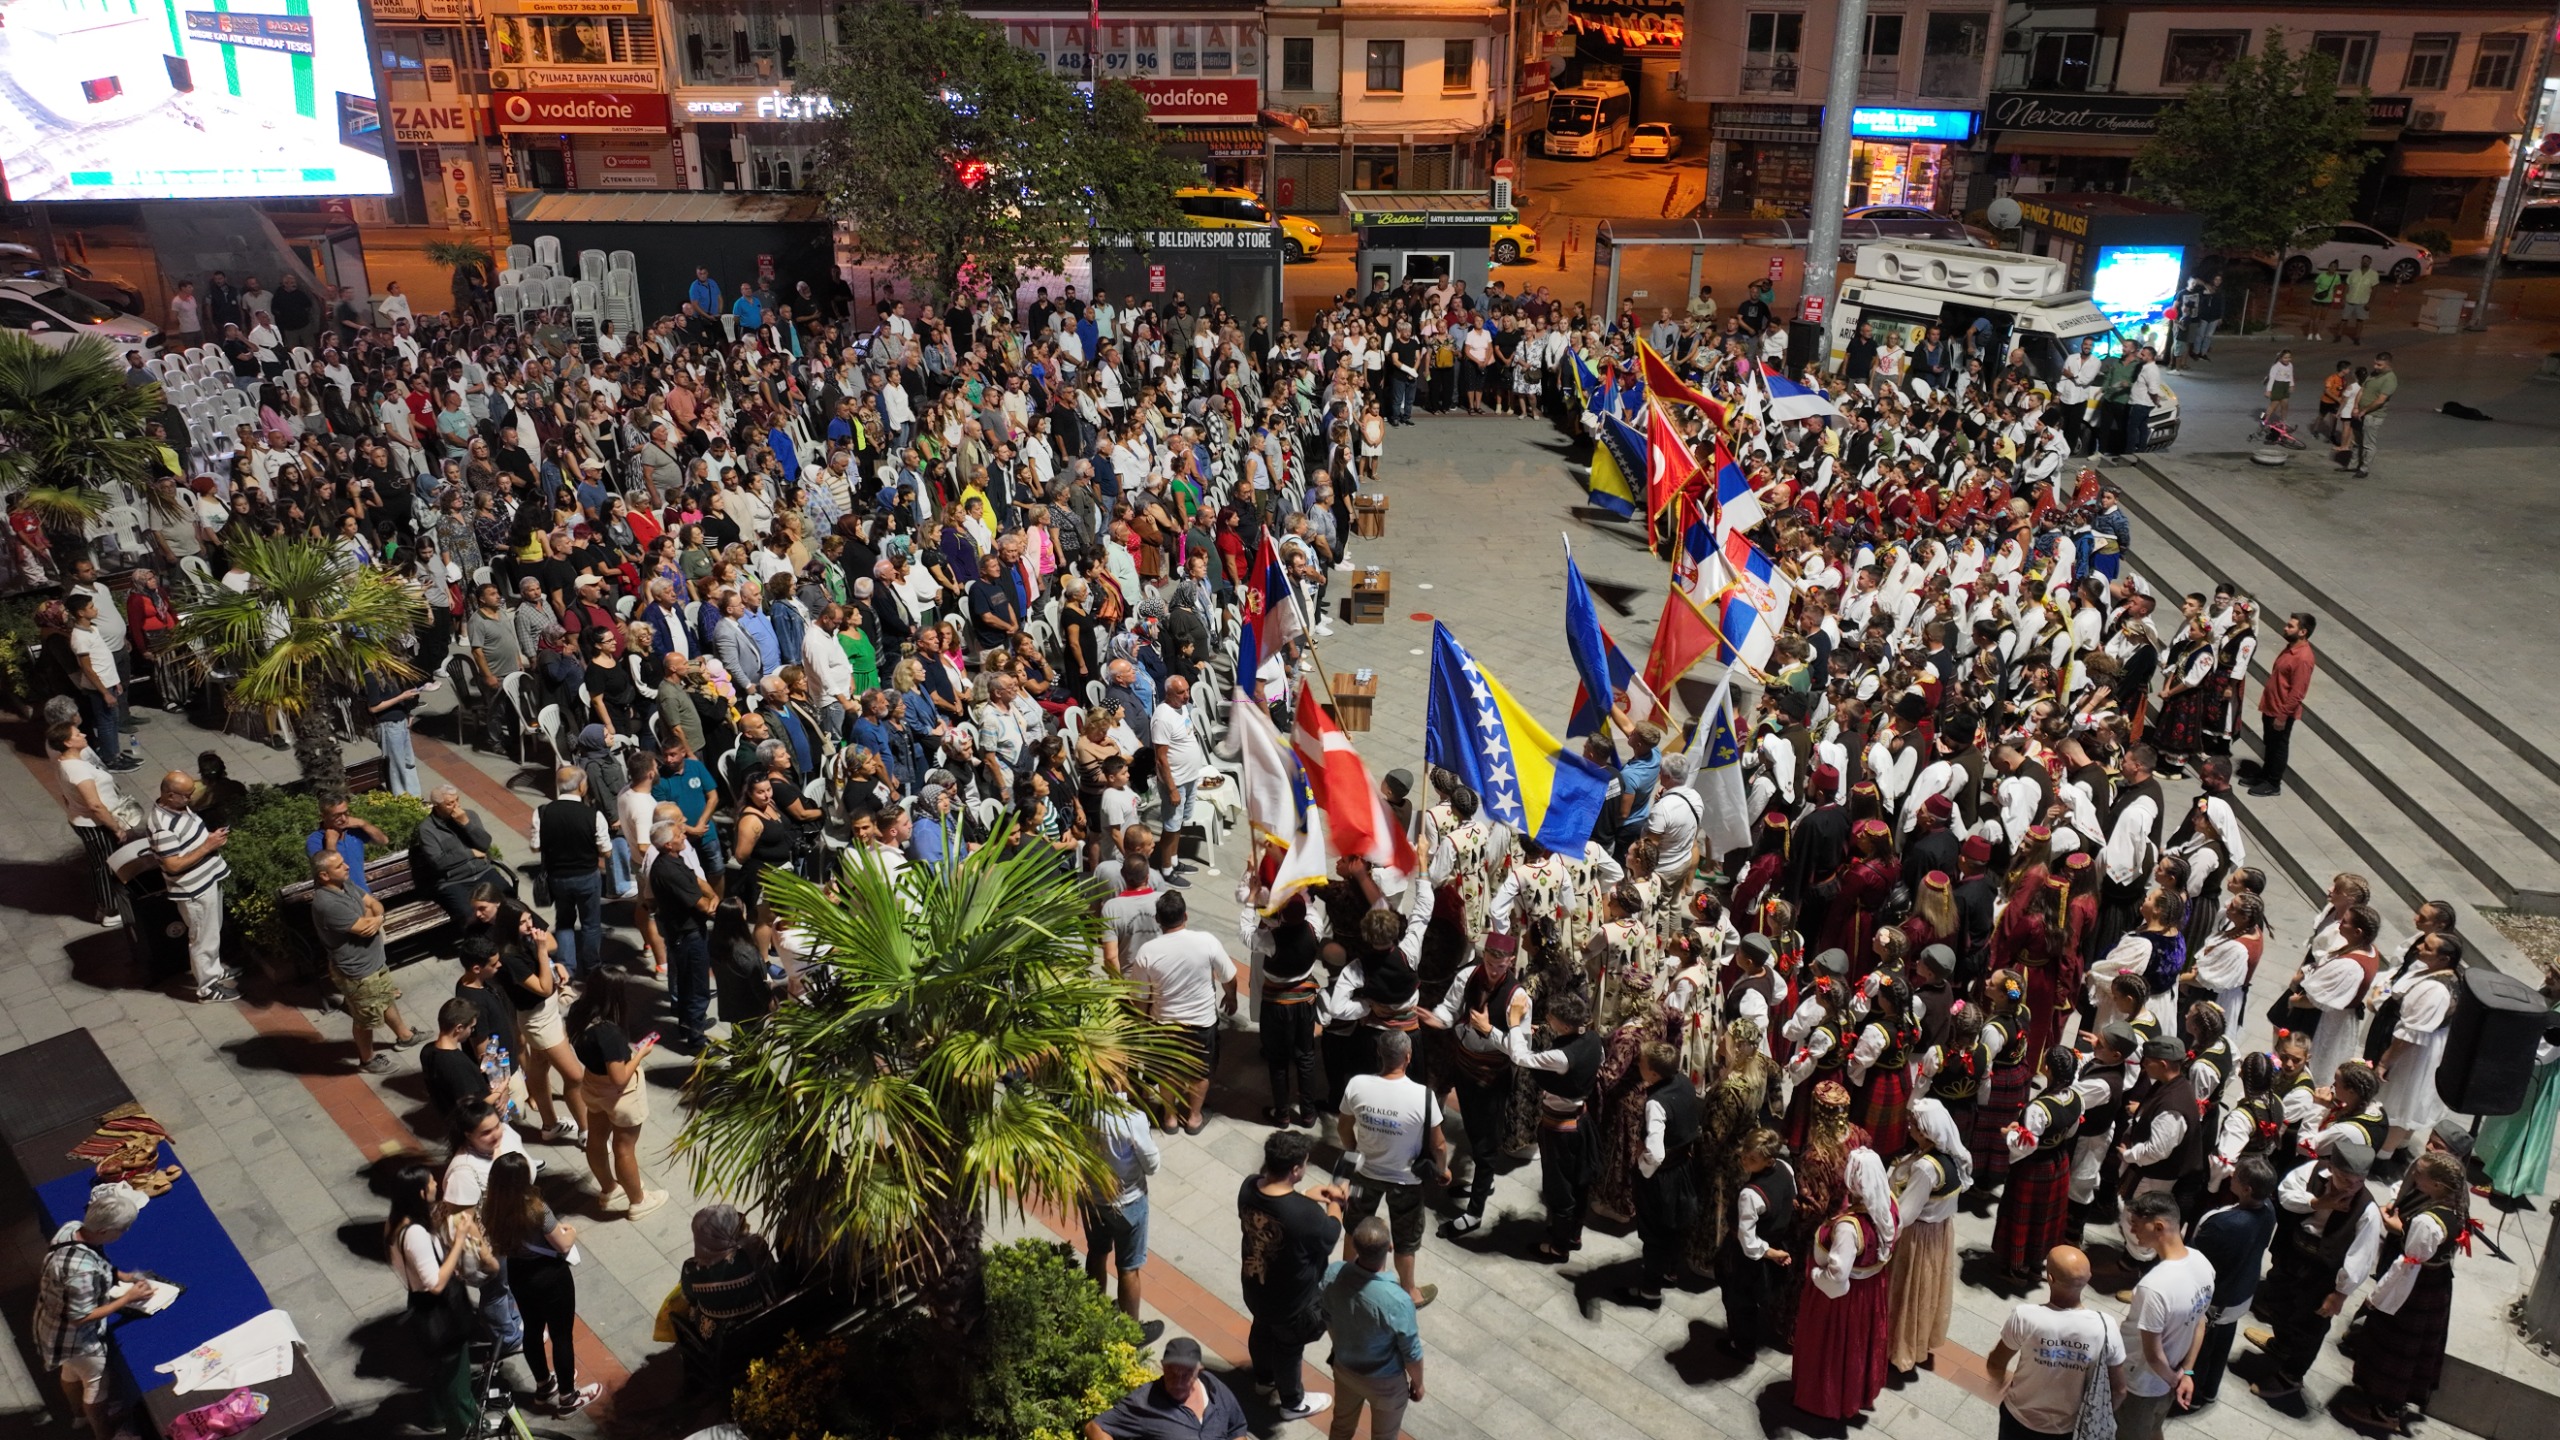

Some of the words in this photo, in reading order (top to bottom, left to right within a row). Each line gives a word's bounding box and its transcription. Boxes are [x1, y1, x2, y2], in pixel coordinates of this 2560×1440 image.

[447, 5, 473, 14] BAŞAN
[1106, 53, 1128, 69] 97
[1136, 52, 1158, 69] 96
[540, 73, 575, 83] YILMAZ
[577, 73, 607, 83] BAYAN
[610, 72, 653, 83] KUAFÖRÜ
[1141, 88, 1228, 106] vodafone
[537, 100, 632, 119] vodafone
[1996, 97, 2095, 127] Nevzat
[1897, 114, 1937, 127] TEKEL
[398, 130, 434, 140] DERYA
[2053, 210, 2089, 237] TAKSİ
[1237, 231, 1271, 248] STORE
[2040, 1337, 2090, 1351] FOLKLOR
